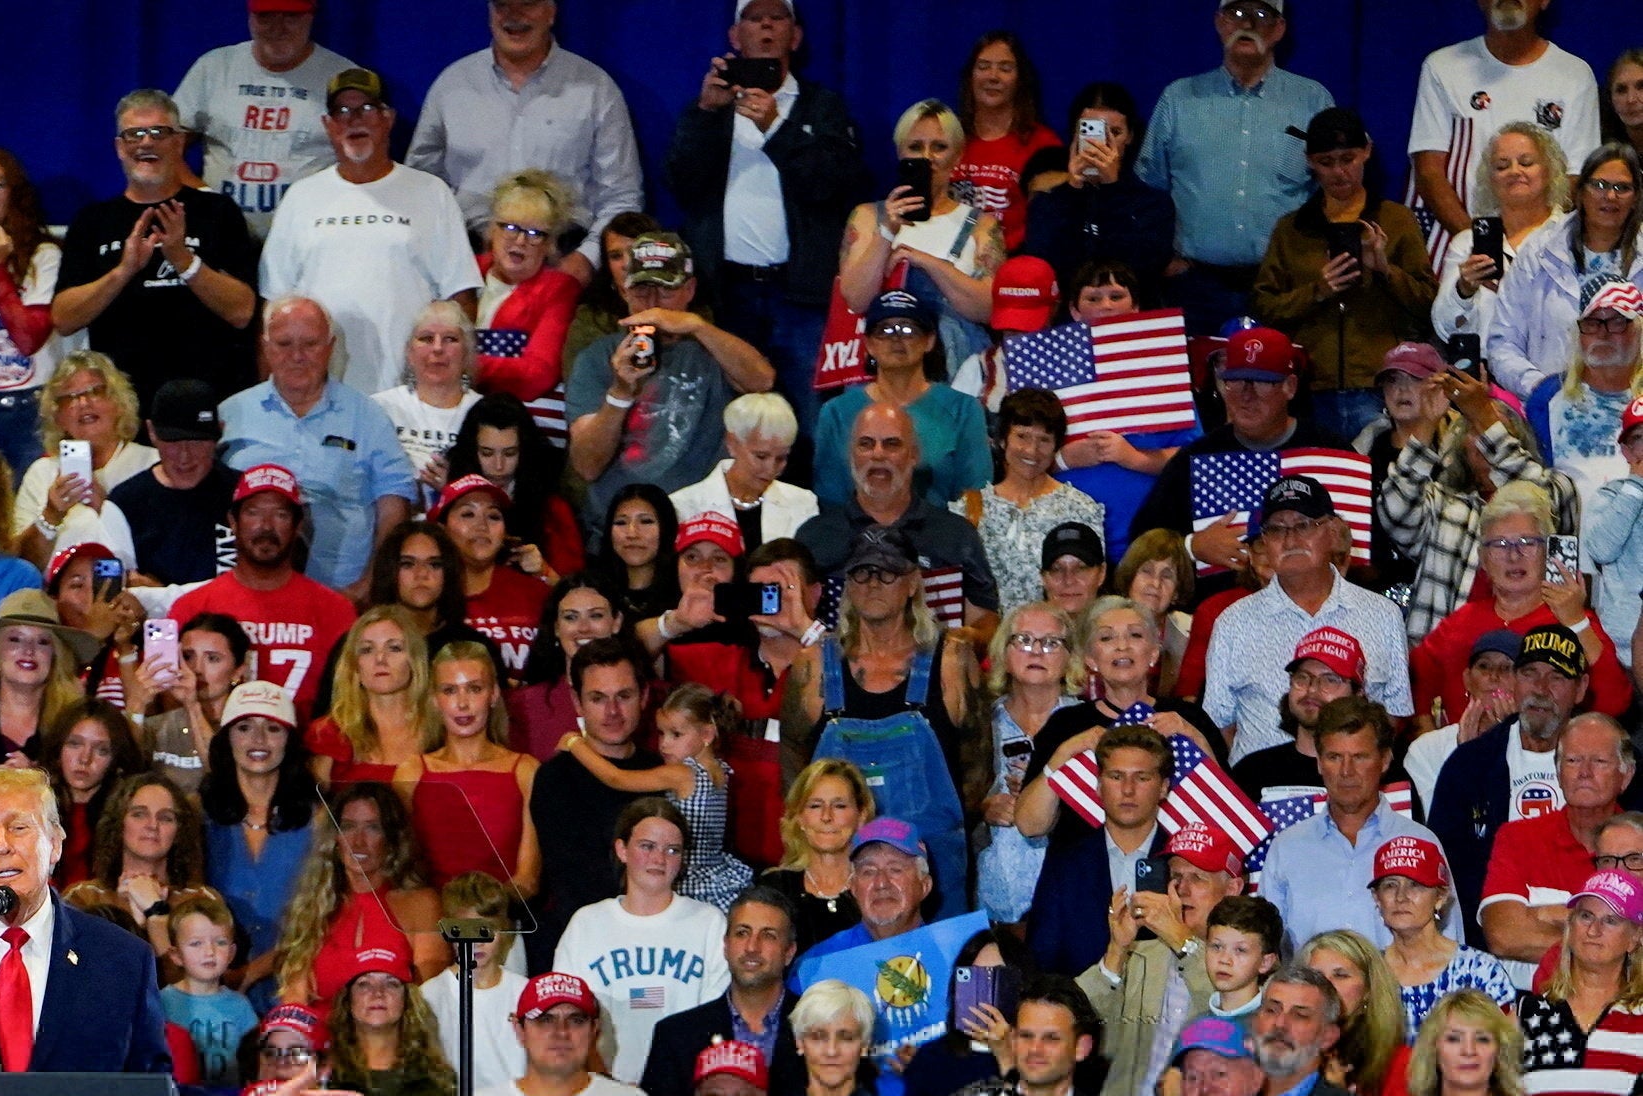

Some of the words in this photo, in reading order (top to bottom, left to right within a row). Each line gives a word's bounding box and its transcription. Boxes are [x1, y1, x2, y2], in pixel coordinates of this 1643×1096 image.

[244, 104, 292, 132] RED
[221, 180, 292, 213] BLU
[314, 214, 412, 228] FREEDOM
[999, 287, 1041, 298] FREEDOM
[396, 425, 459, 442] FREED
[242, 620, 314, 646] RUMP
[1523, 630, 1577, 660] TRUMP
[1389, 837, 1418, 850] KEEP
[1379, 847, 1427, 863] AMERICA
[1384, 858, 1419, 871] GREAT
[588, 946, 705, 988] TRUMP
